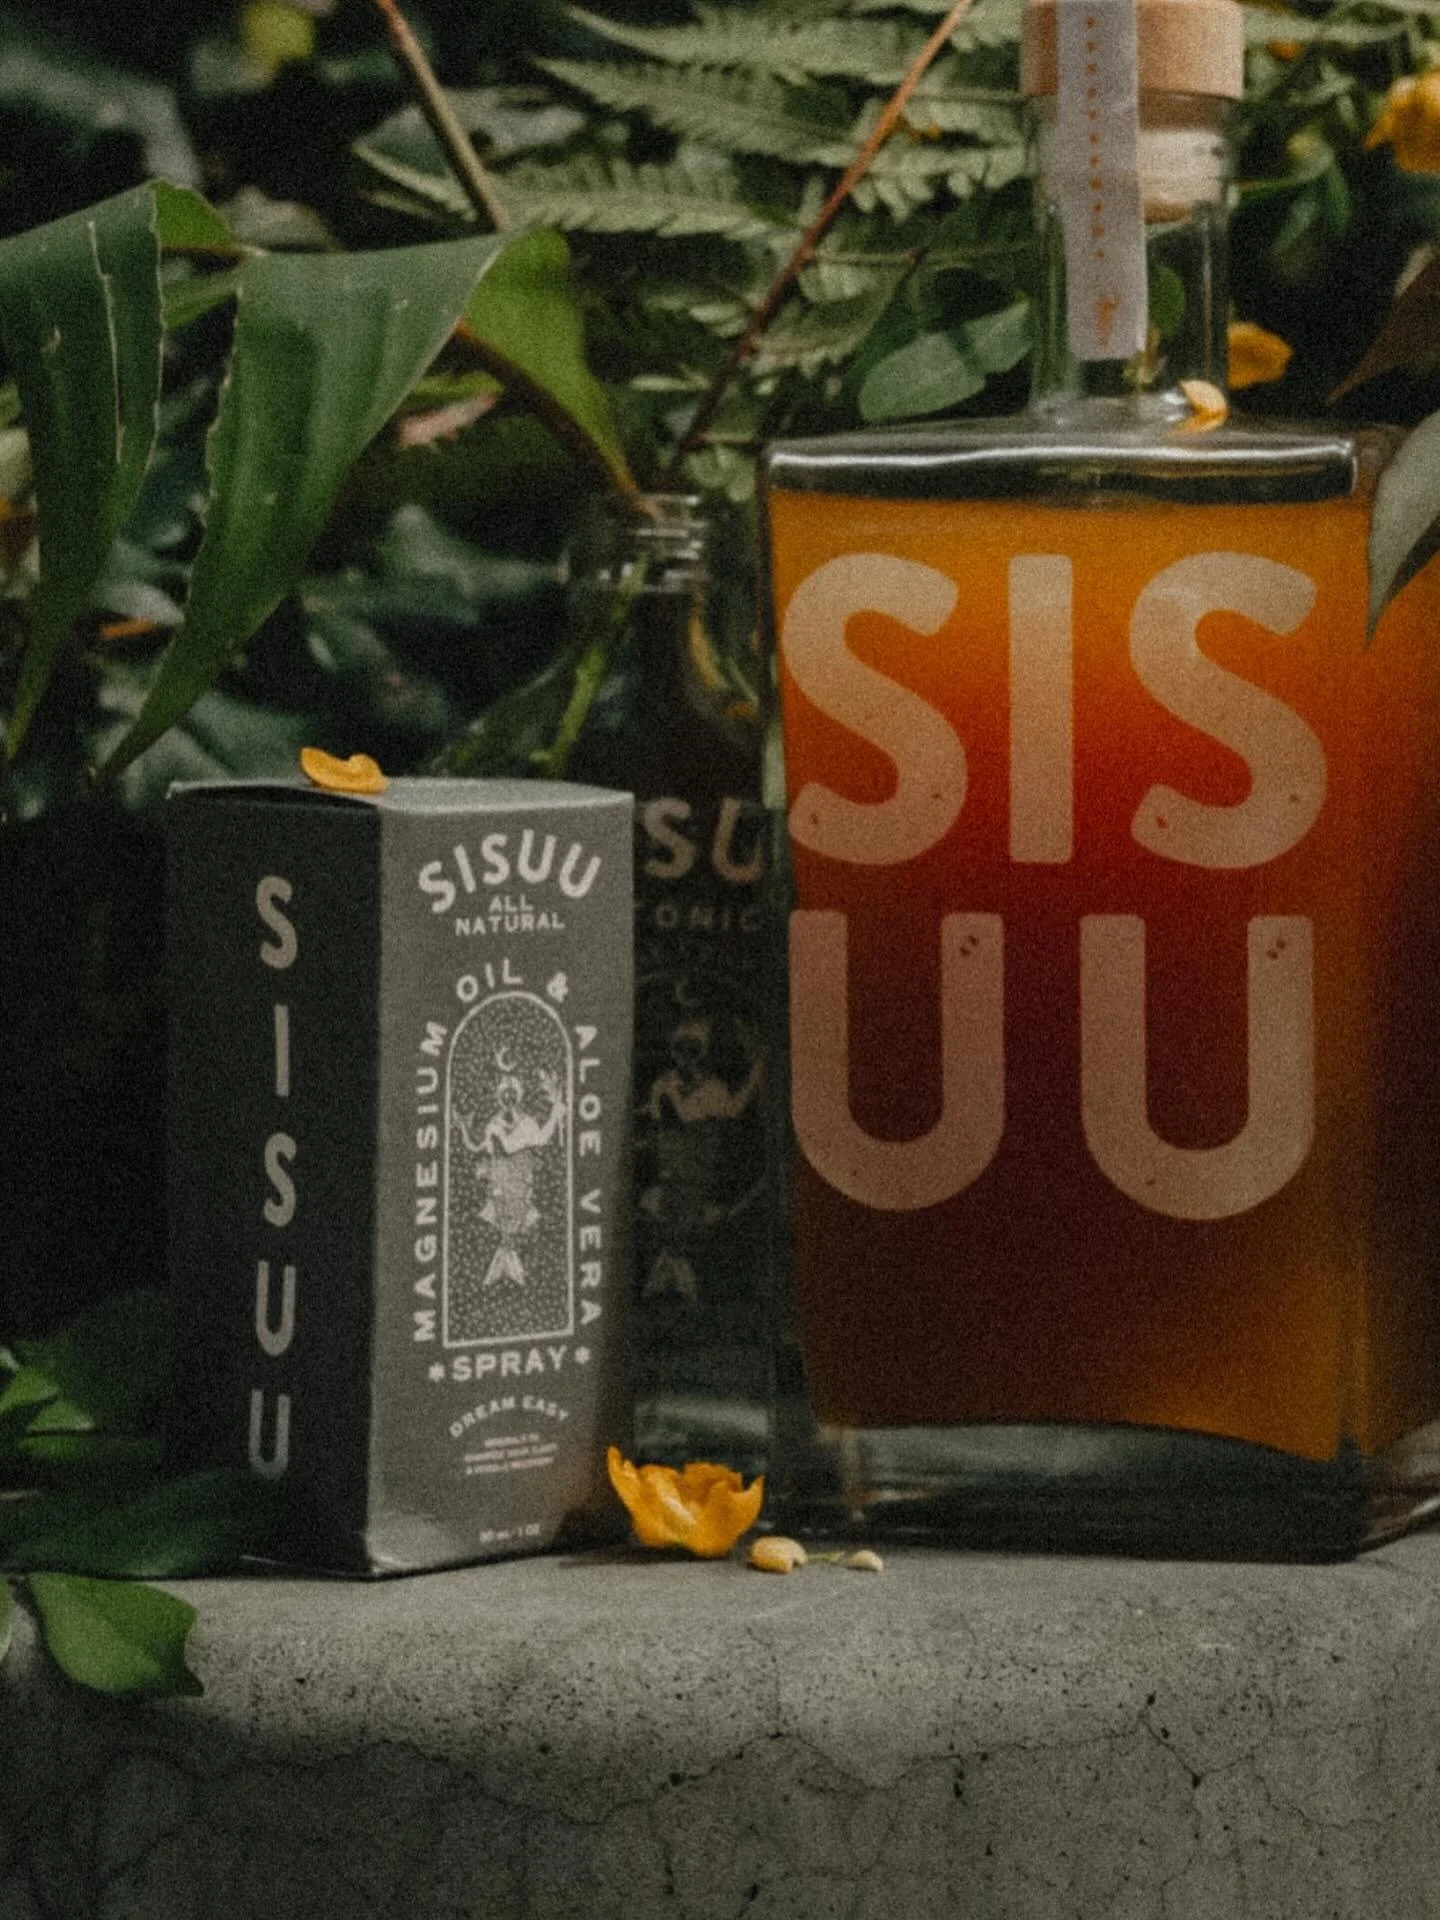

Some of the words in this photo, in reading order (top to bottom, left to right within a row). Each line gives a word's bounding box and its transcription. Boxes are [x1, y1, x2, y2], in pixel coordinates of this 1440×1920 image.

[782, 552, 1327, 869] SIS
[418, 828, 601, 913] SISUU
[455, 912, 566, 936] NATURAL
[489, 894, 535, 912] ALL
[634, 902, 765, 933] ONIC
[456, 958, 524, 1002] OIL
[574, 1024, 602, 1157] ALOE
[789, 909, 1316, 1241] UU
[248, 875, 299, 1479] SISUU
[414, 1021, 448, 1342] MAGNESIUM
[579, 1188, 602, 1325] VERA
[451, 1345, 568, 1382] SPRAY
